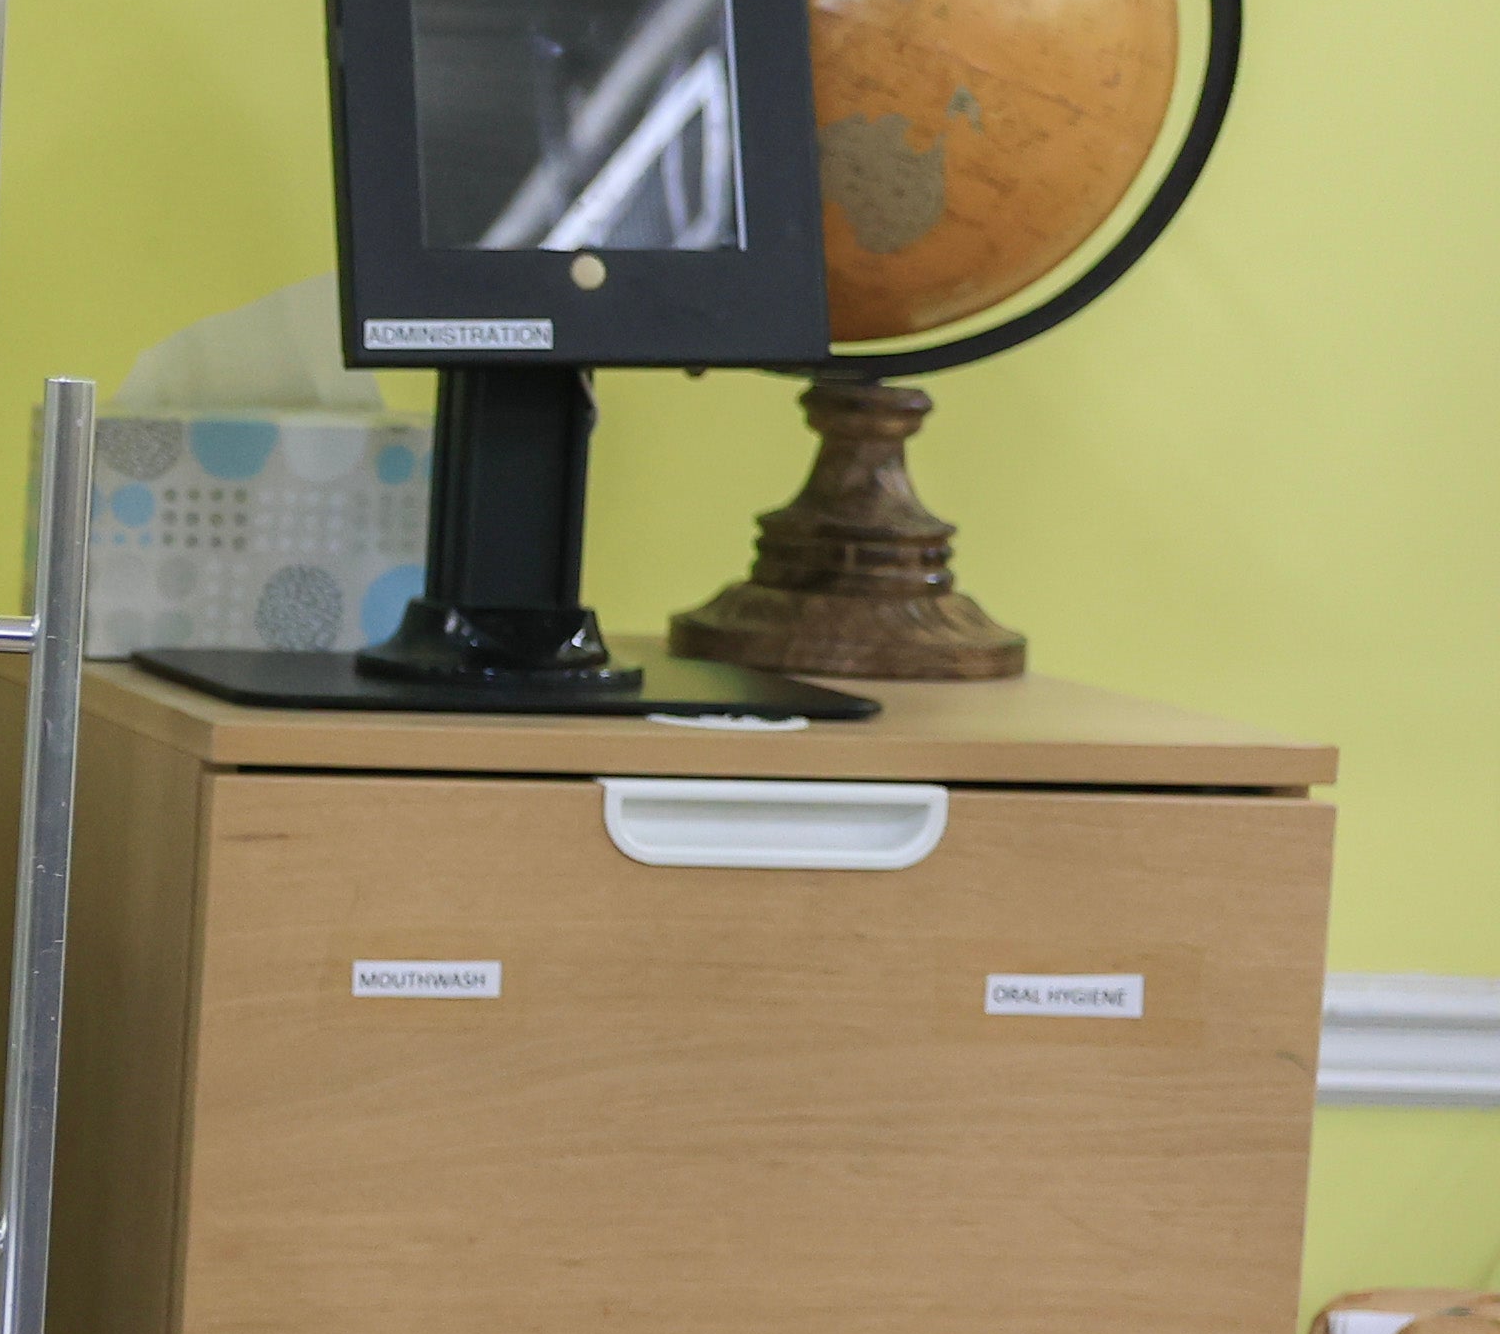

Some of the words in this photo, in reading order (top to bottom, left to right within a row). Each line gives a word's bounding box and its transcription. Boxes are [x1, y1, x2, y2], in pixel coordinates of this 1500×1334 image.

[368, 324, 551, 345] ADMINISTRATION
[360, 972, 486, 989] MOUTHWASH
[994, 985, 1041, 1005] ORAL
[1048, 987, 1126, 1007] HYGIENE
